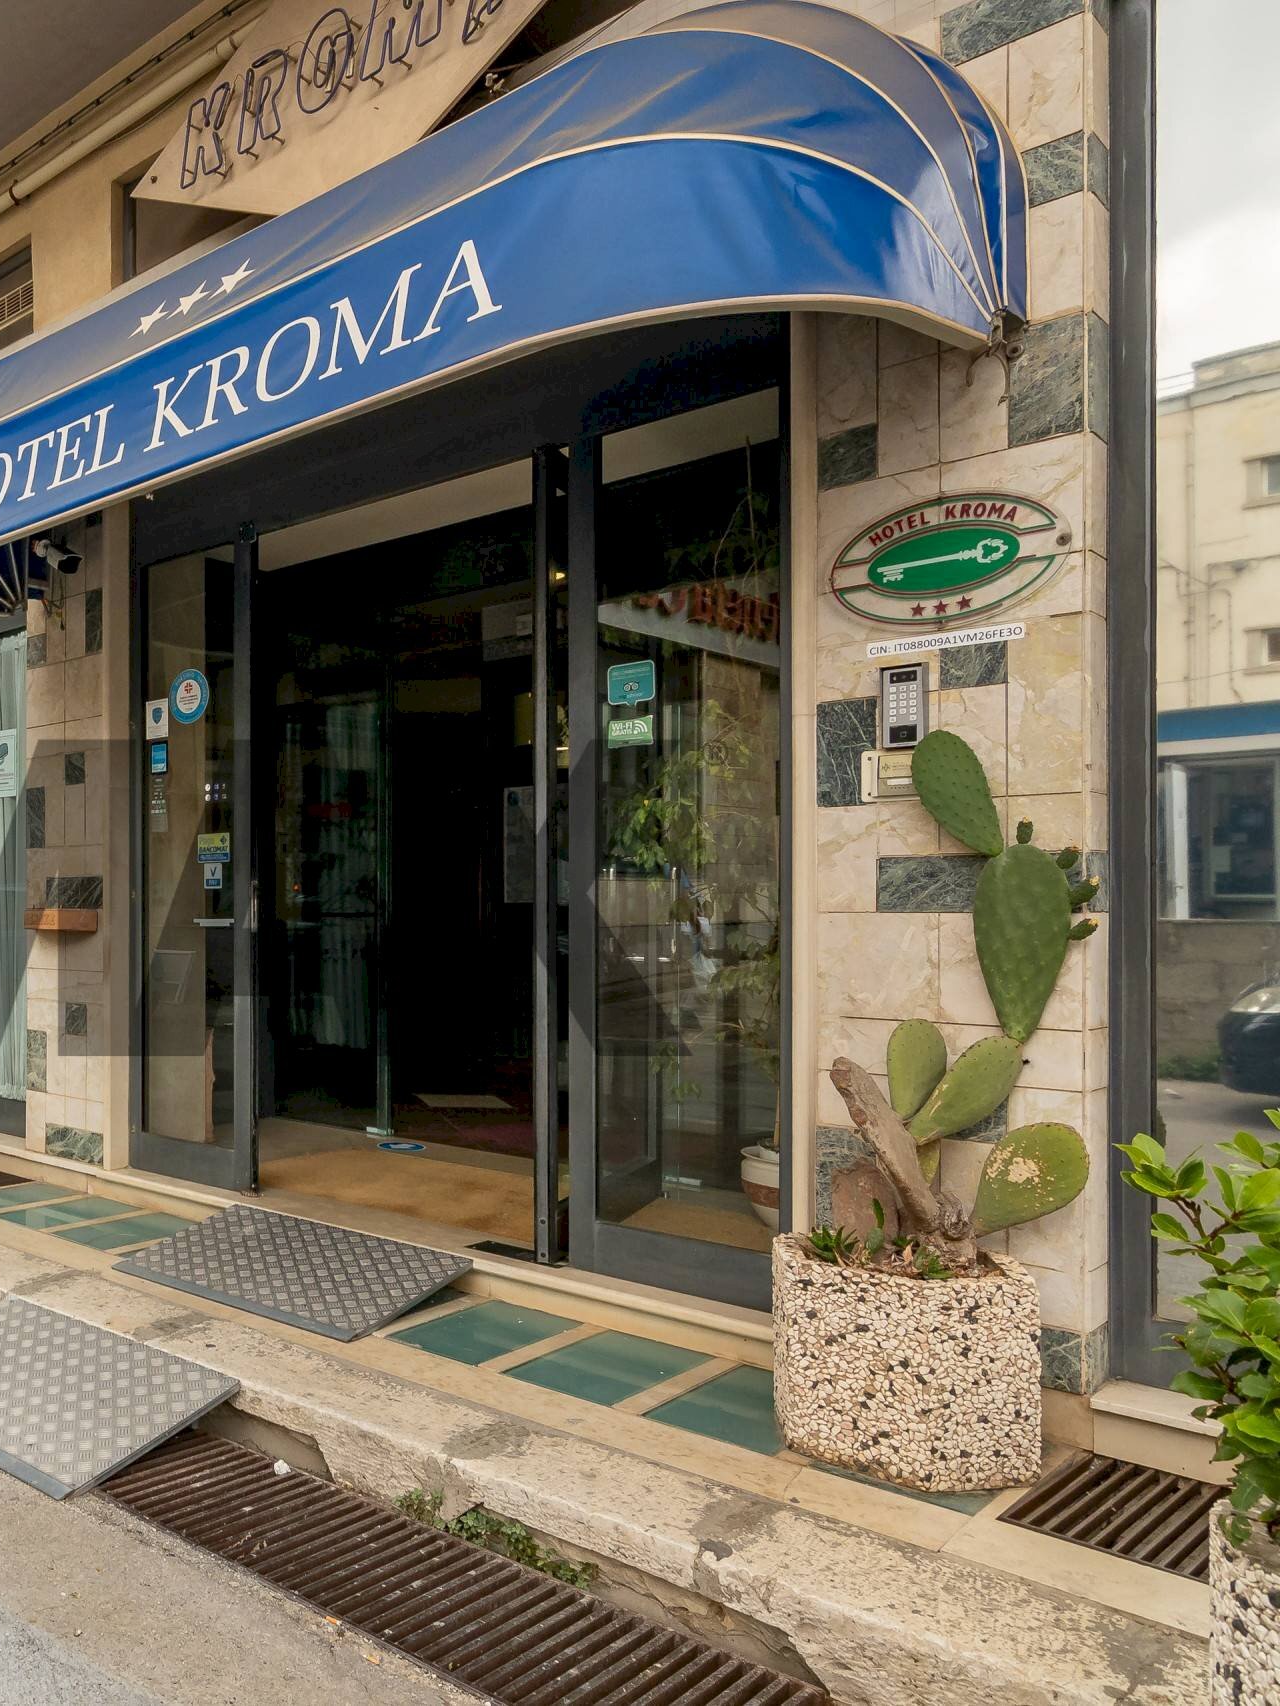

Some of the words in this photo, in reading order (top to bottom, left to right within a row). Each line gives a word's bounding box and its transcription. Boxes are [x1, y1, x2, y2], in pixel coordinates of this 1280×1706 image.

[143, 239, 503, 453] KROMA
[868, 511, 931, 547] HOTEL
[944, 502, 1018, 522] KROMA
[869, 645, 892, 656] CIN:
